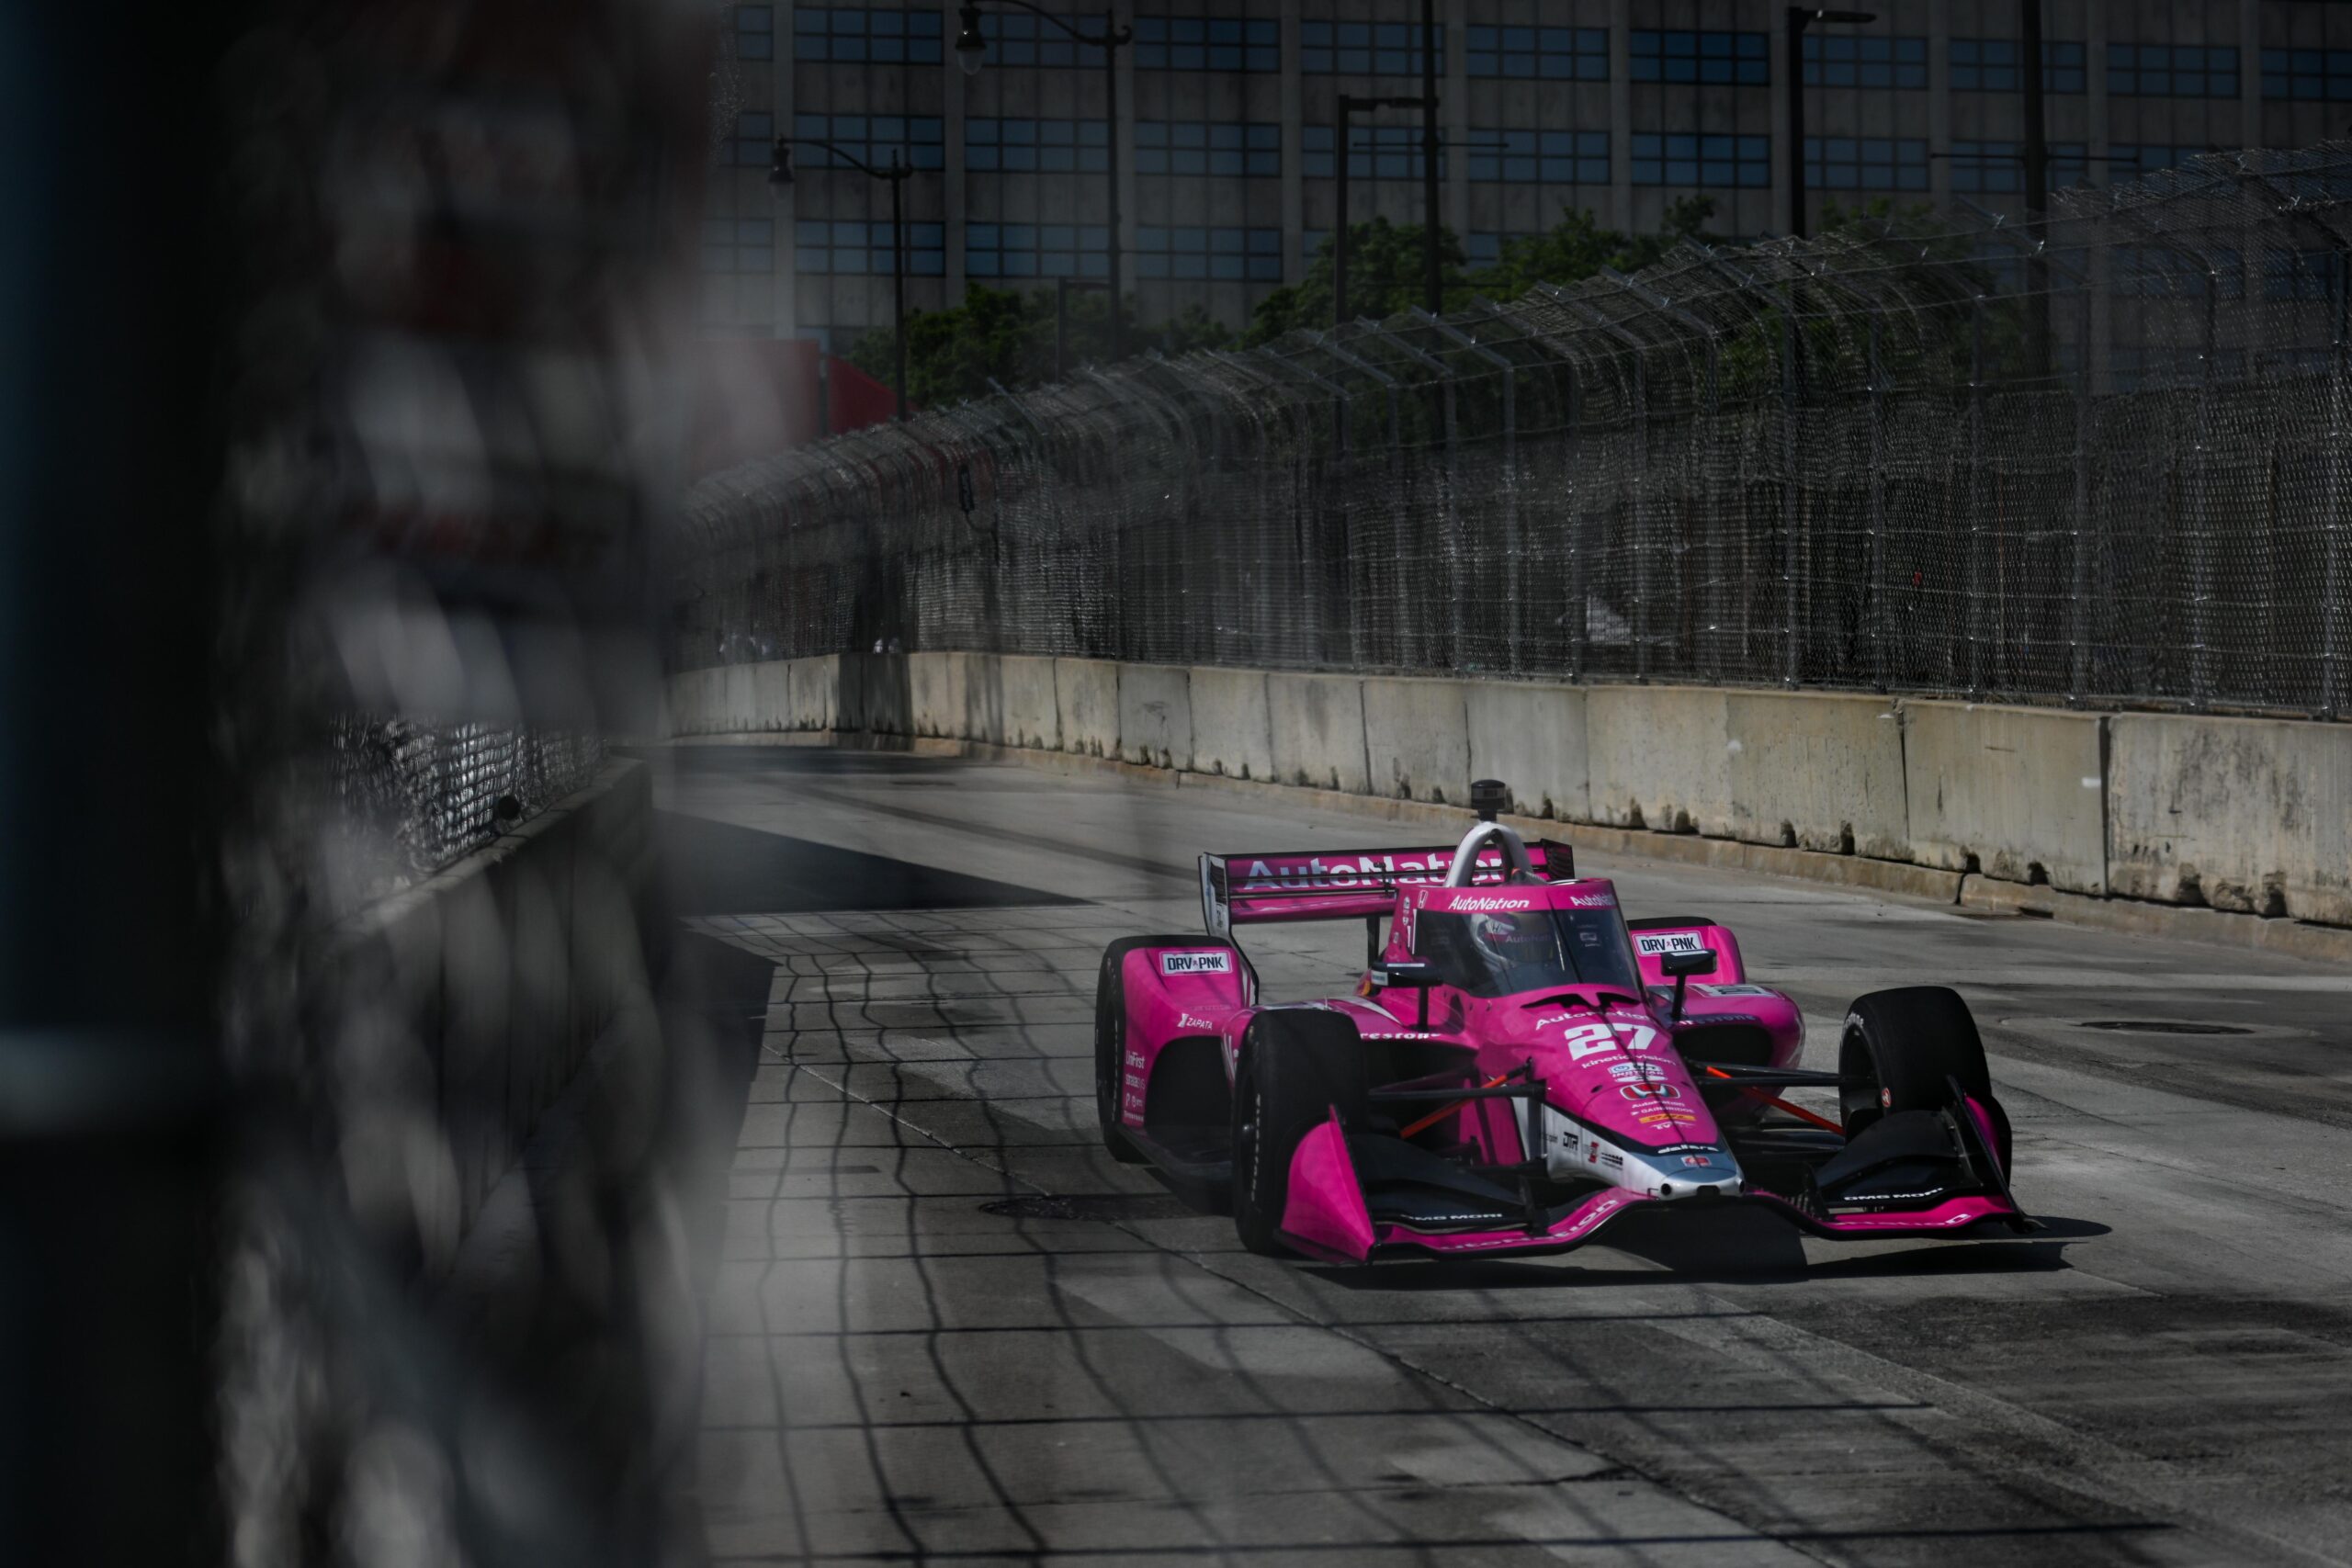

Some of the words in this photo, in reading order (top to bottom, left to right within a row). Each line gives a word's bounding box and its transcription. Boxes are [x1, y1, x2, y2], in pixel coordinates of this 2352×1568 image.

[1243, 852, 1504, 890] AutoNaton
[1448, 895, 1530, 910] AutoNation
[1641, 939, 1666, 952] DRV
[1672, 937, 1697, 951] PNK
[1167, 957, 1193, 971] DRV
[1199, 956, 1224, 969] PNK
[1186, 1017, 1213, 1031] ZAPATA
[1564, 1022, 1657, 1061] 27
[1640, 1106, 1696, 1114] GAINRIDGE
